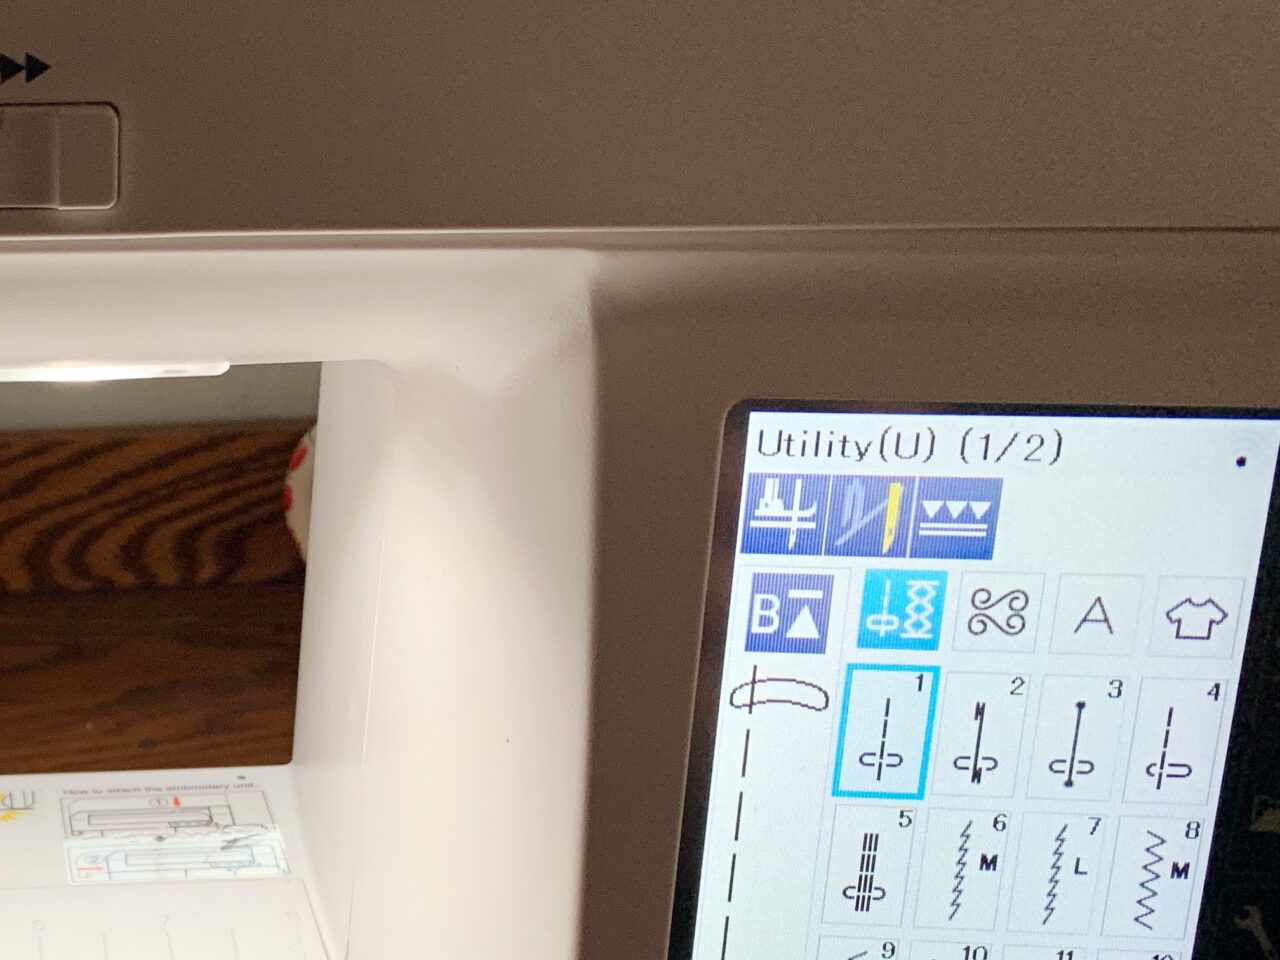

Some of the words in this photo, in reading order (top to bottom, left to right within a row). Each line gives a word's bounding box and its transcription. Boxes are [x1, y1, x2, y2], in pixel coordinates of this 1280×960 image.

[756, 427, 936, 463] Utility(U)
[959, 427, 1065, 465] (1/2)
[751, 594, 779, 634] B
[1074, 597, 1114, 634] A
[914, 674, 925, 692] 1
[1010, 677, 1024, 696] 2
[1108, 680, 1122, 699] 3
[1207, 683, 1221, 701] 4
[898, 810, 912, 828] 5
[993, 814, 1006, 832] 6
[1088, 817, 1101, 835] 7
[1186, 821, 1200, 840] 8
[979, 854, 998, 871] M
[1074, 857, 1087, 875] L
[1171, 862, 1189, 880] M
[881, 942, 896, 960] 9
